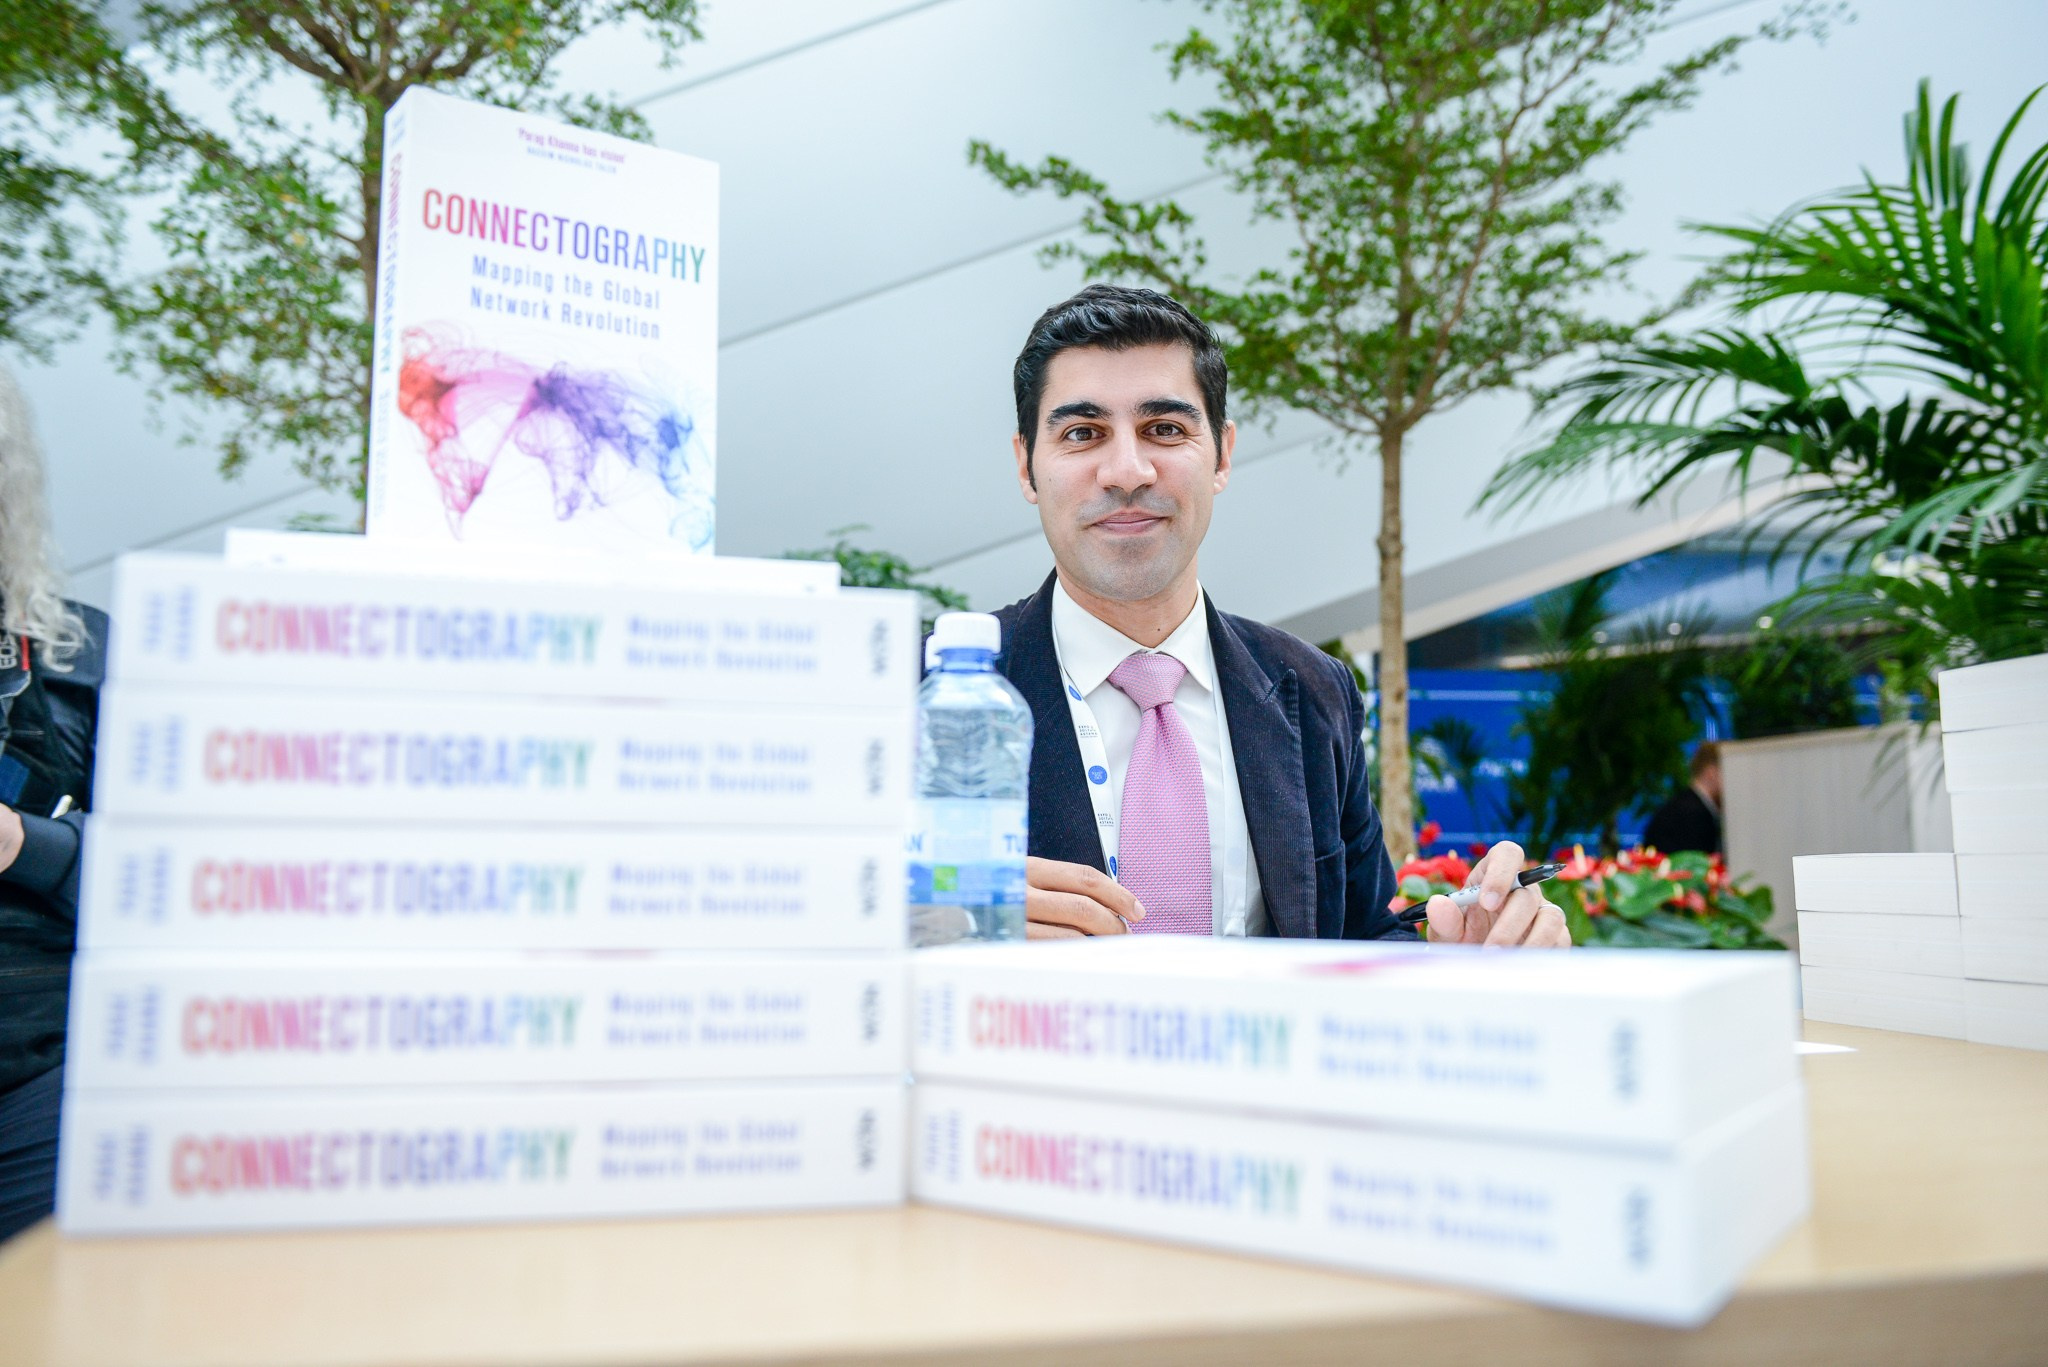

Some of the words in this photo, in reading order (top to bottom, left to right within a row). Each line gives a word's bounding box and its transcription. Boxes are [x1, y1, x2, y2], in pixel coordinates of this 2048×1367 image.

[422, 187, 707, 285] CONNECTOGRAPHY
[470, 285, 551, 322] Network
[561, 302, 661, 341] Revolution
[472, 254, 554, 293] Mapping
[564, 272, 594, 298] the
[603, 279, 661, 311] Global
[216, 598, 602, 664] CONNECTOGRAPHY
[204, 728, 594, 788] CONNECTOGRAPHY
[191, 858, 585, 916] CONNECTOGRAPHY
[181, 992, 583, 1058] CONNECTOGRAPHY
[969, 994, 1297, 1068] CONNECTOGRAPHY
[171, 1126, 578, 1196] CONNECTOGRAPHY
[976, 1124, 1306, 1220] CONNECTOGRAPHY
